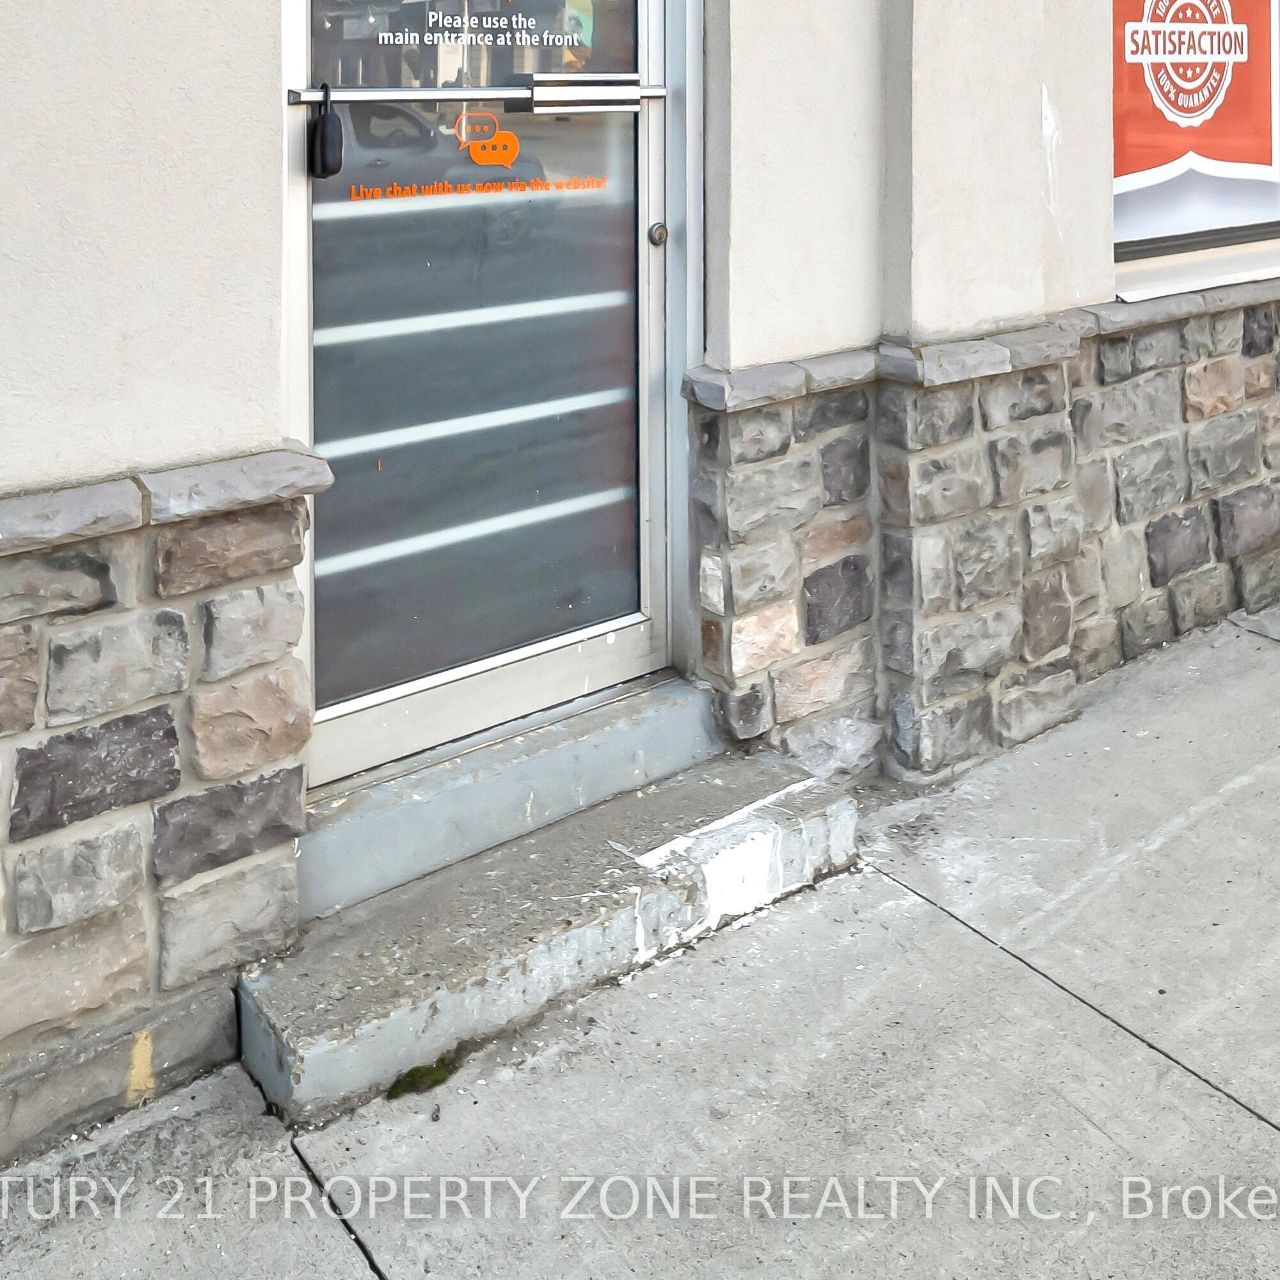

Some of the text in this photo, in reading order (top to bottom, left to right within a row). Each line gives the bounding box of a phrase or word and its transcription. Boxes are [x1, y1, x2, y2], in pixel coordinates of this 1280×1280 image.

[428, 11, 536, 29] Please use the
[378, 28, 580, 46] main entrance at the front
[1130, 29, 1245, 56] SATISFACTION
[1157, 67, 1221, 108] 100% GUARANTEE
[350, 184, 382, 201] Live
[385, 182, 417, 199] chat
[421, 180, 453, 196] with
[455, 183, 472, 194] us
[474, 182, 504, 193] now
[529, 177, 551, 191] the
